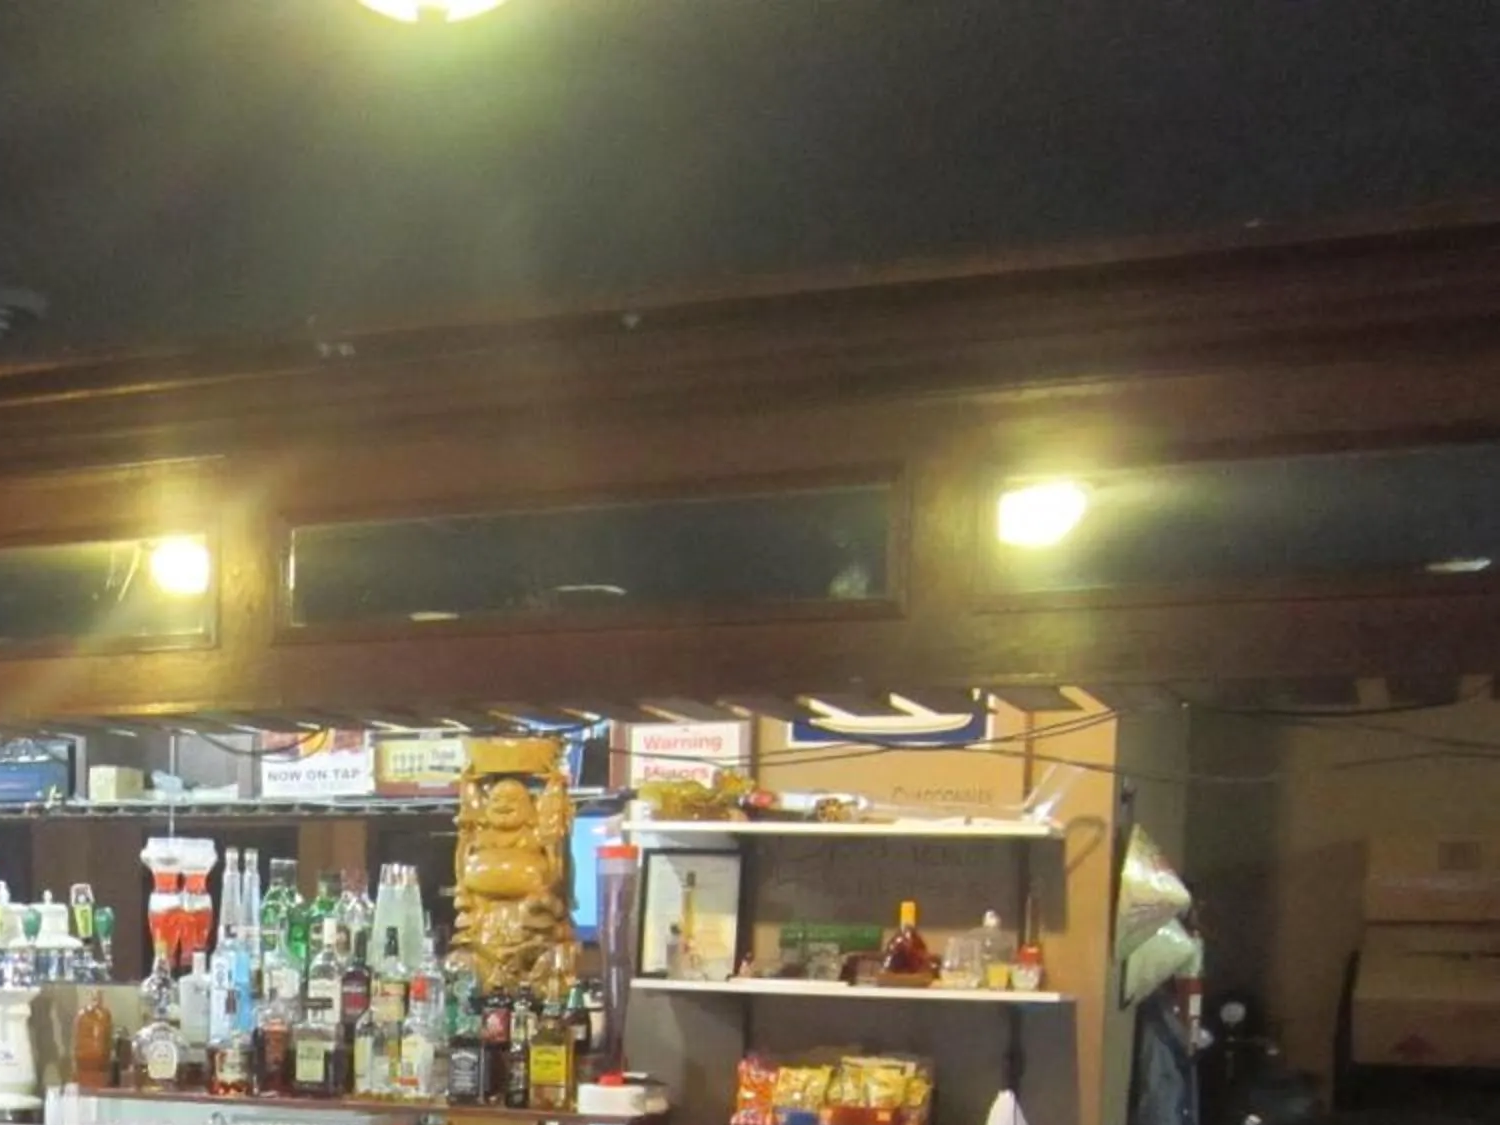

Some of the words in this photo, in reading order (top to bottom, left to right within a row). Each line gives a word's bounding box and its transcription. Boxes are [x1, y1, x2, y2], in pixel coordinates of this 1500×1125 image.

[643, 735, 723, 752] Warning
[267, 770, 303, 781] NOW
[306, 769, 328, 780] ON
[332, 767, 361, 780] TAP
